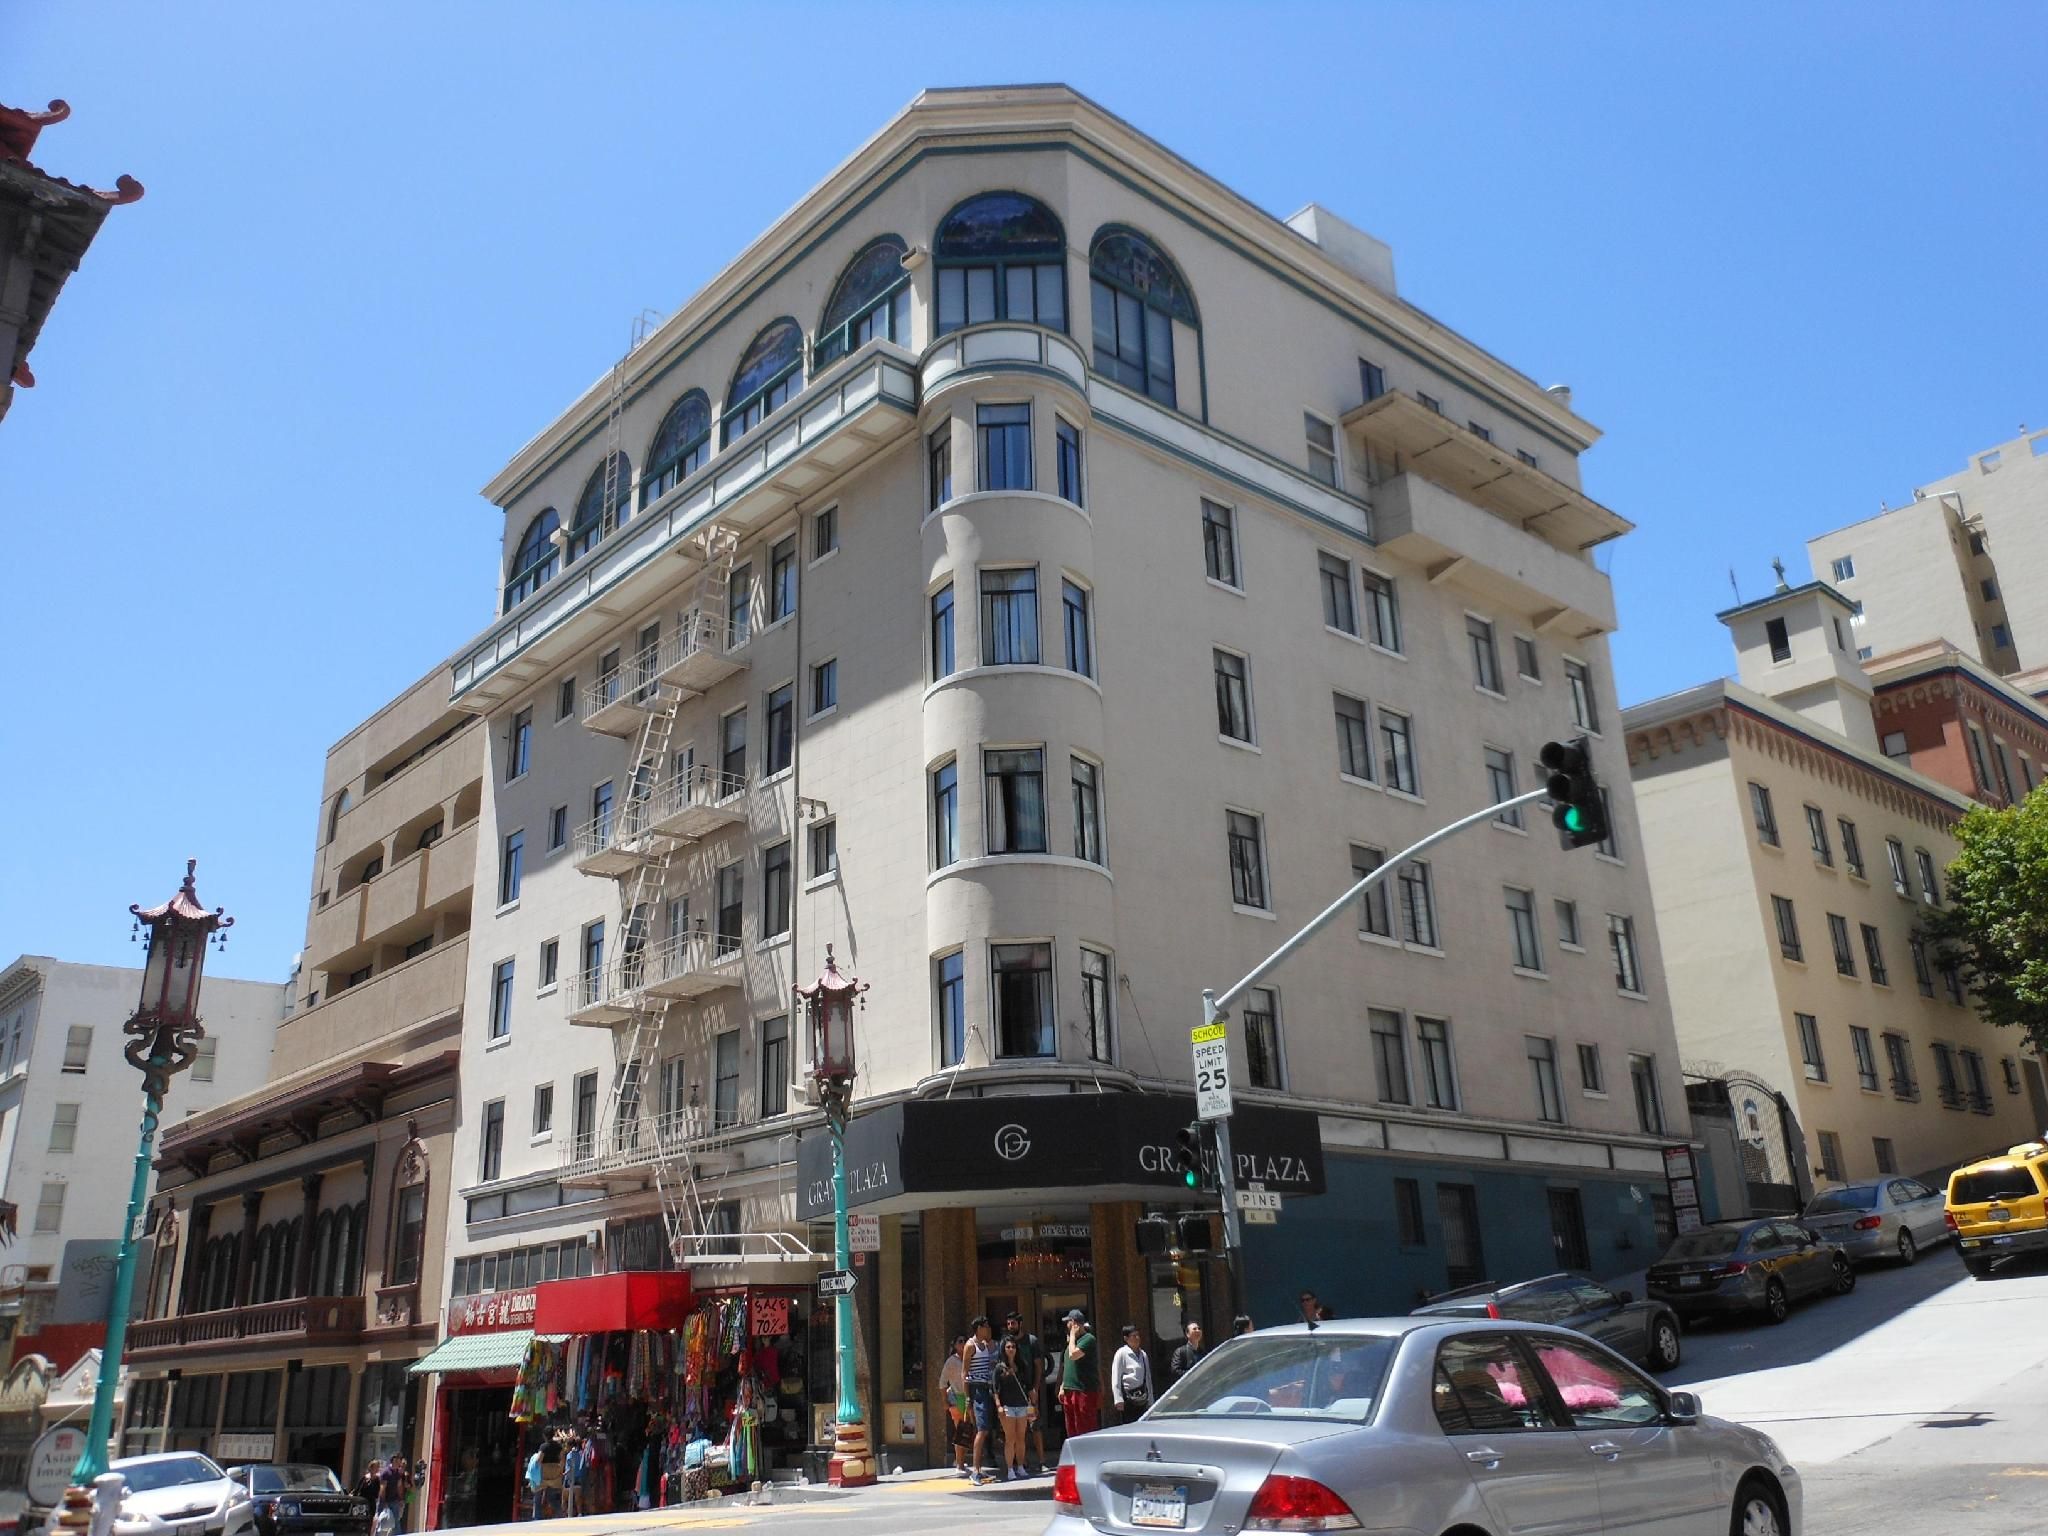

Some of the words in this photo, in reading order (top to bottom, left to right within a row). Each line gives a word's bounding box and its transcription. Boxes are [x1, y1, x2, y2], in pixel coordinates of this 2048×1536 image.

[1193, 1025, 1224, 1040] SCHOOL
[1196, 1045, 1224, 1058] SPEED
[1199, 1057, 1221, 1069] LIMIT
[1197, 1069, 1227, 1092] 25
[1236, 1154, 1311, 1182] PLAZA
[849, 1161, 888, 1194] PLAZA
[1242, 1194, 1276, 1207] PINE
[821, 1279, 833, 1289] ONE
[834, 1278, 846, 1288] WAY
[511, 1294, 536, 1312] DRAGO
[755, 1298, 786, 1313] SALE
[757, 1319, 780, 1334] 70%
